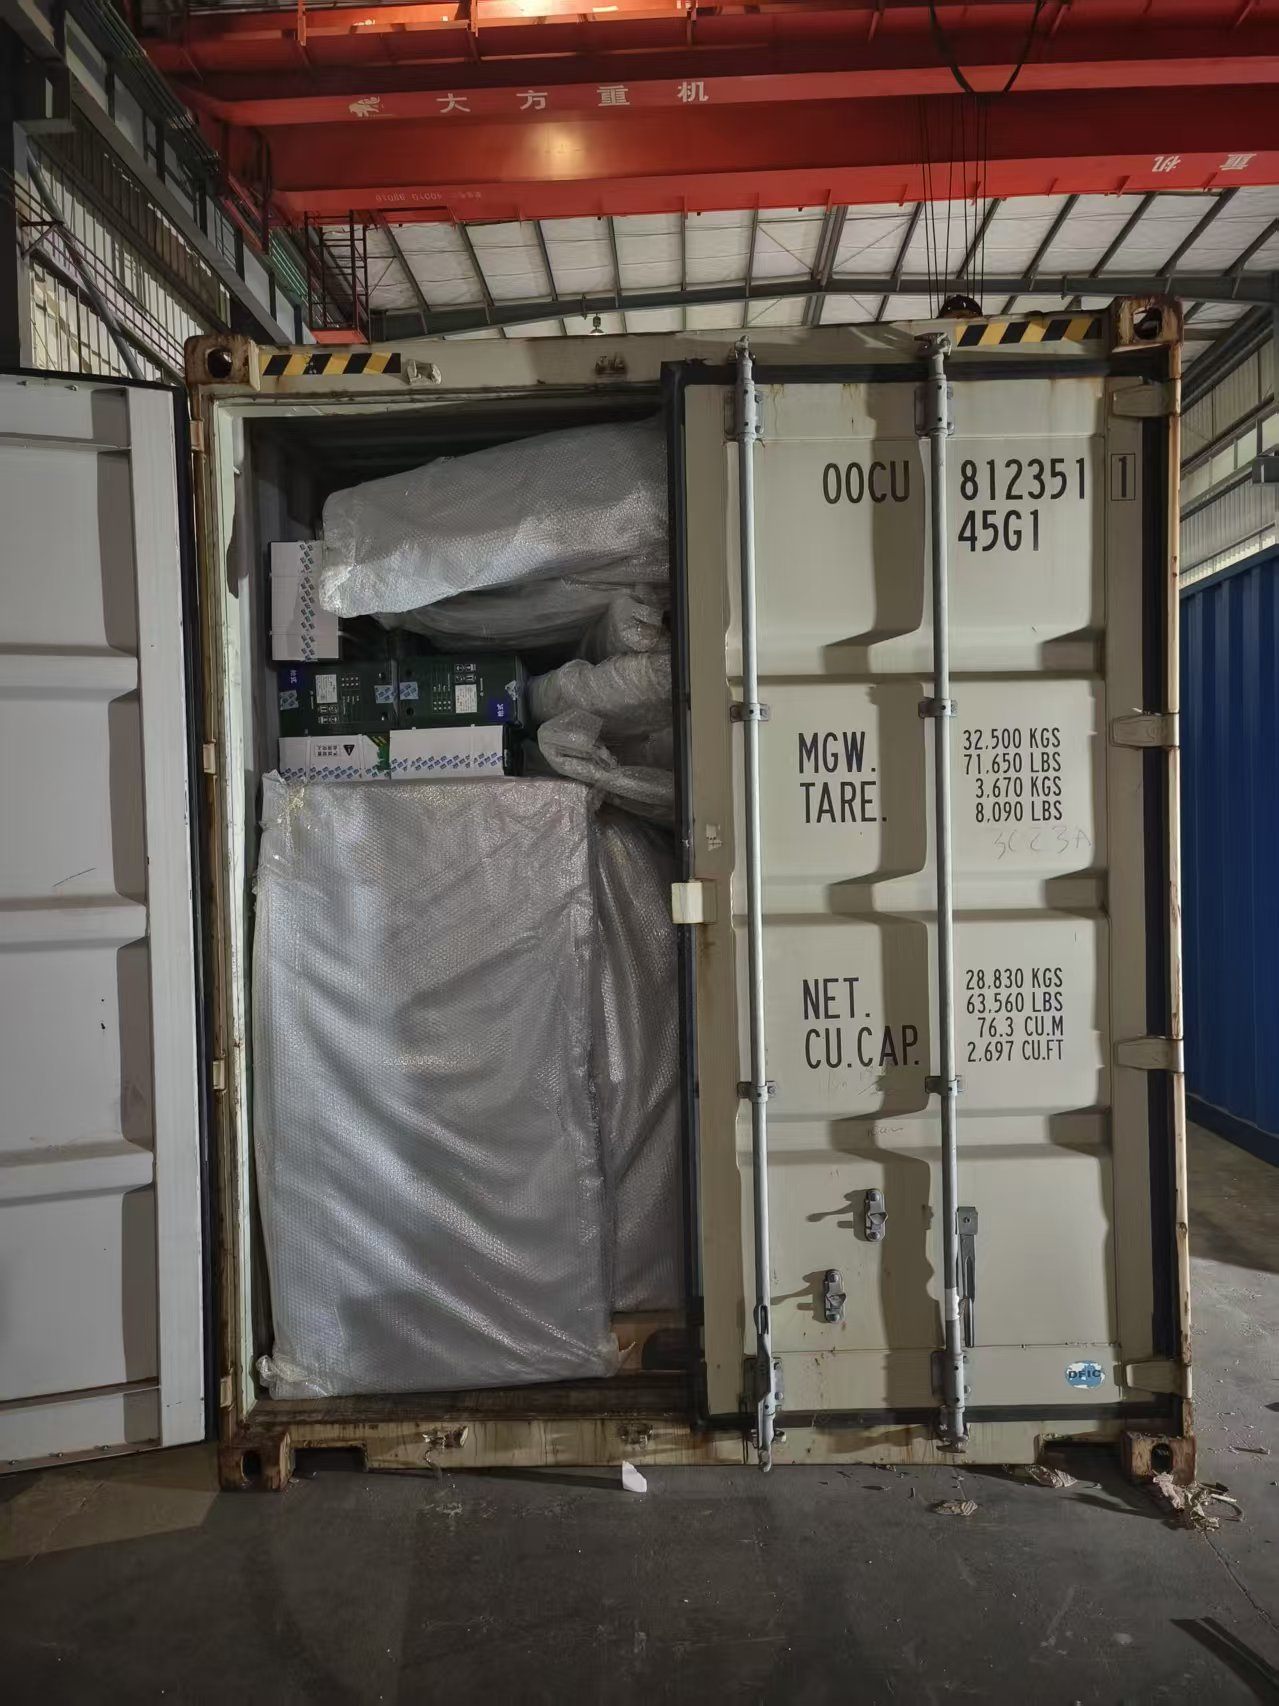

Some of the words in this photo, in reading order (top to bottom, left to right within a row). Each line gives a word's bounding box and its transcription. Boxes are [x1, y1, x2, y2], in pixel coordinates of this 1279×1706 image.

[436, 81, 709, 114] 大方重机
[960, 458, 1085, 500] 812351
[957, 509, 1040, 552] 45G1
[798, 731, 876, 774] MGW.
[1030, 728, 1061, 748] KGS
[1031, 752, 1062, 773] LBS
[800, 781, 887, 823] TARE.
[1031, 776, 1062, 797] KGS
[1031, 801, 1063, 821] LBS
[803, 977, 871, 1020] NET.
[1031, 968, 1063, 989] KGS
[1032, 992, 1063, 1013] LBS
[804, 1024, 919, 1069] CU.CAP.
[977, 1017, 1015, 1038] 76.3
[1024, 1016, 1064, 1036] CU.M
[1022, 1040, 1064, 1060] CU.FT
